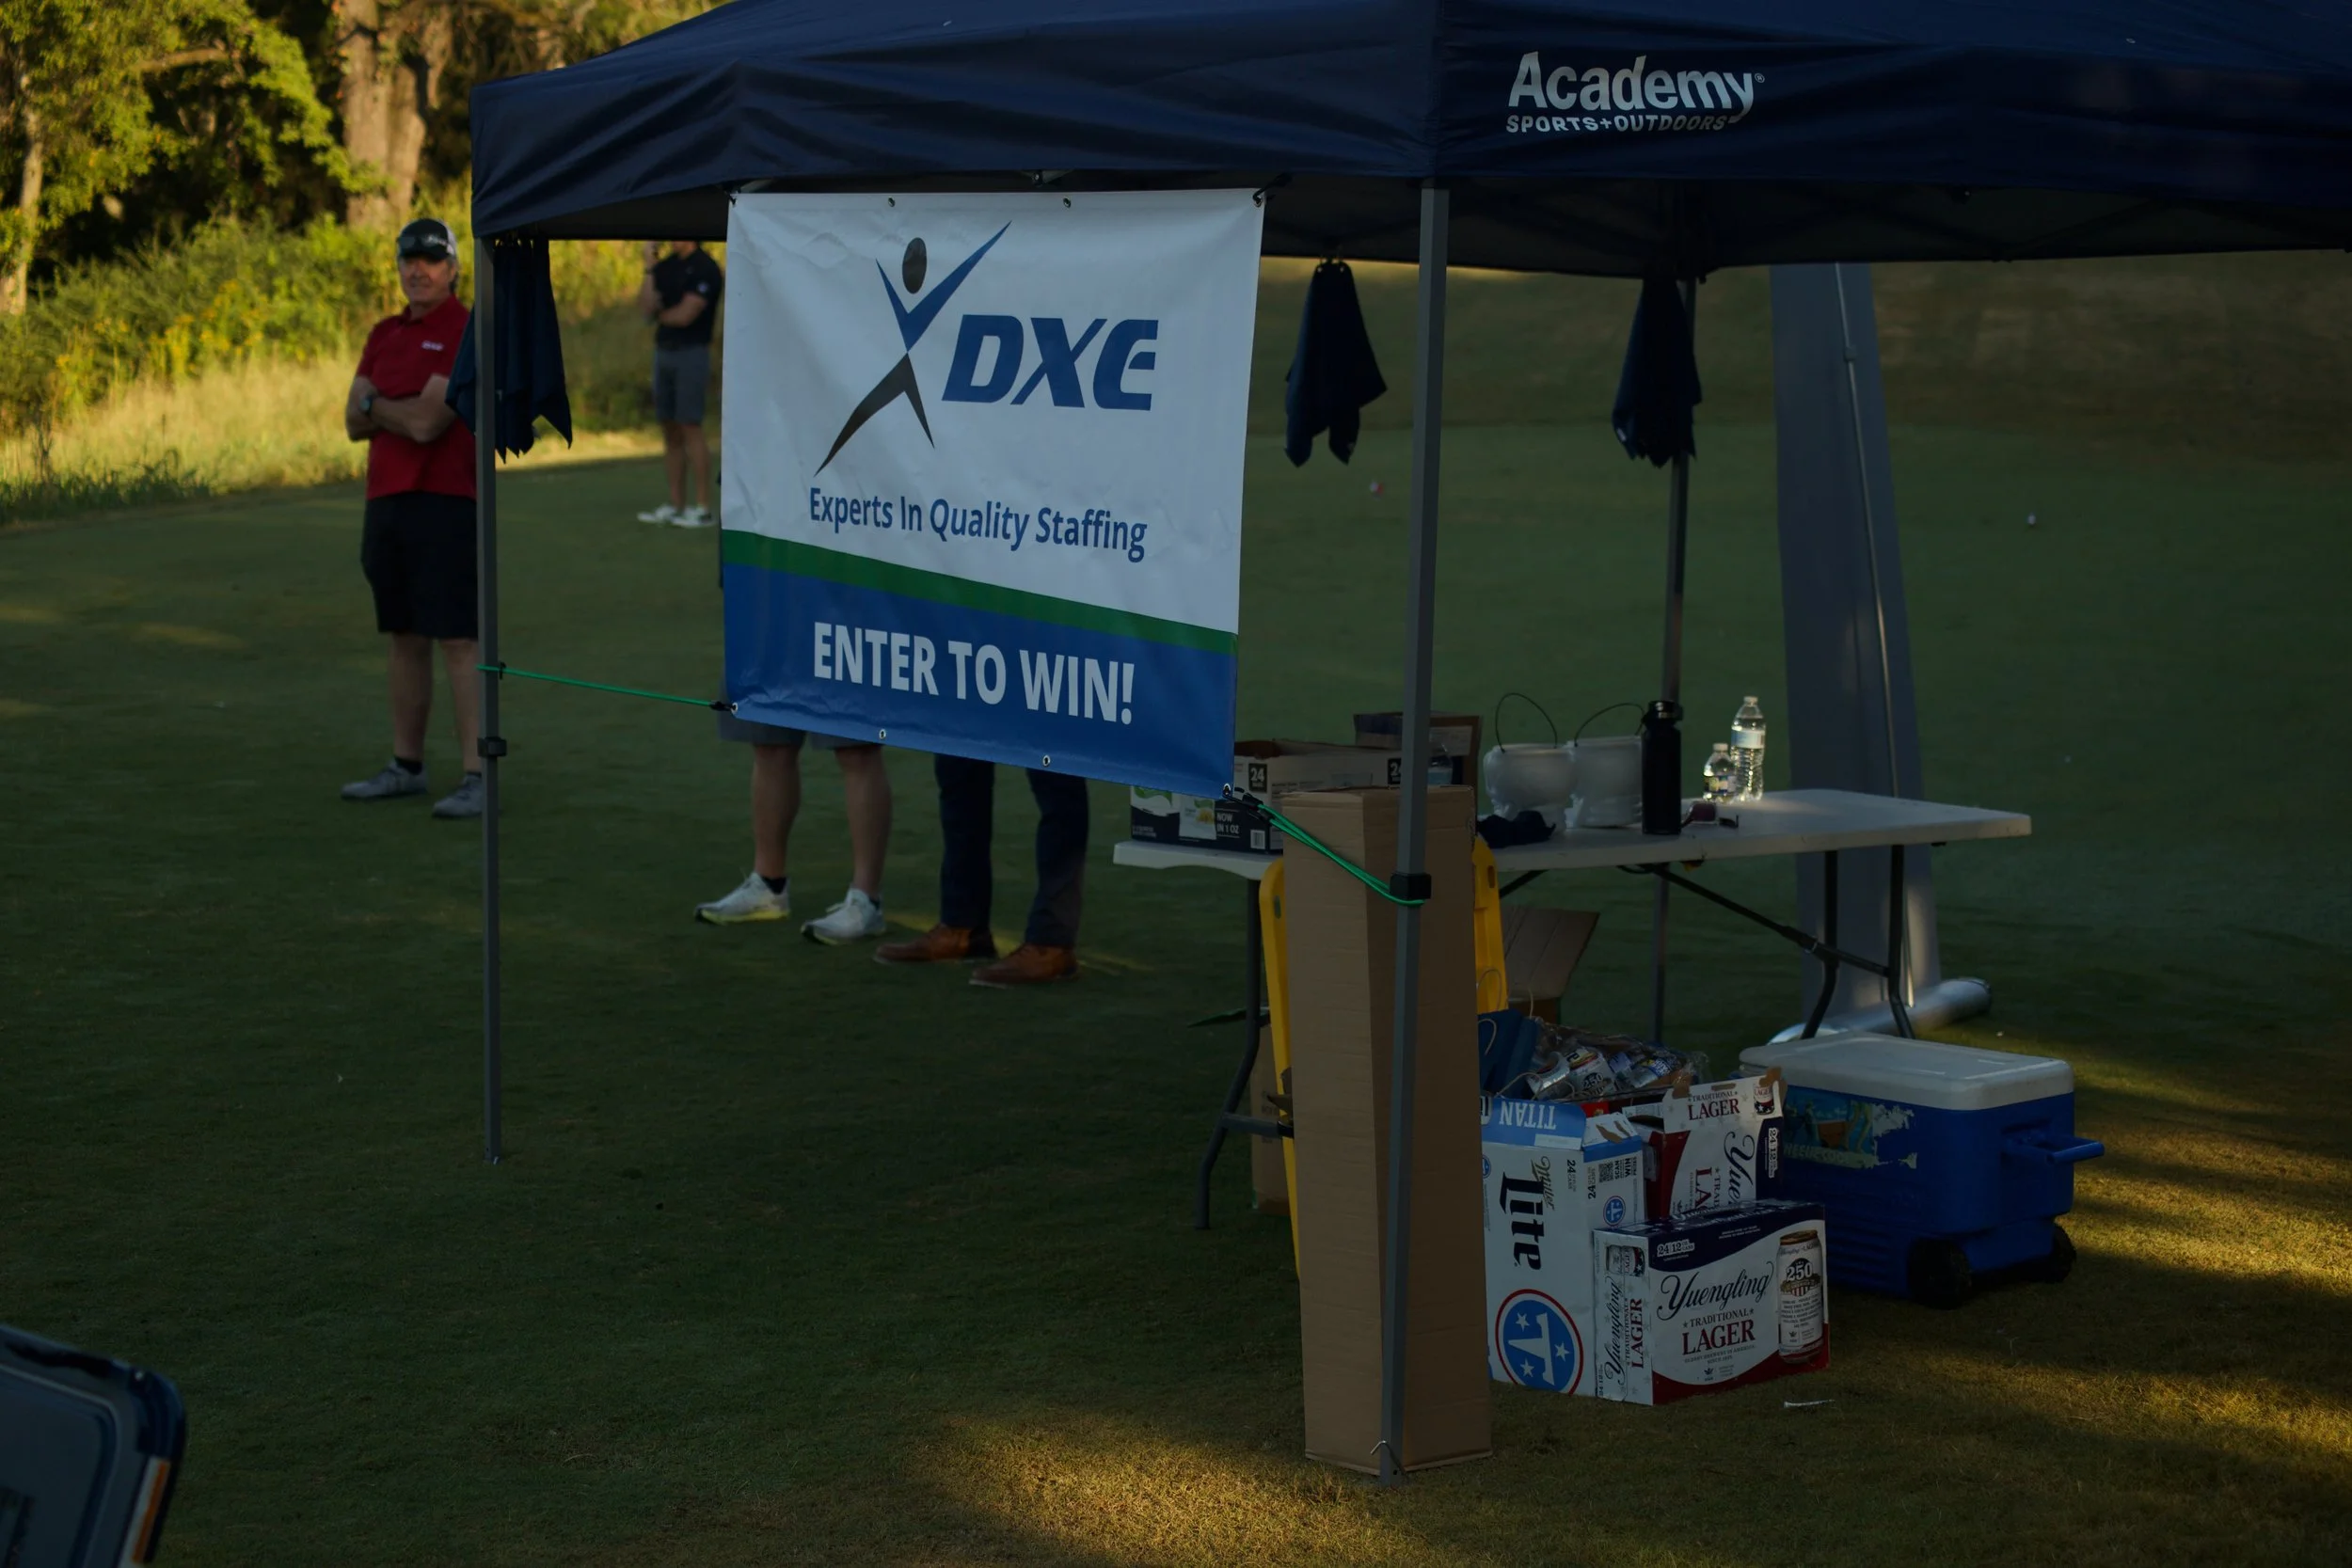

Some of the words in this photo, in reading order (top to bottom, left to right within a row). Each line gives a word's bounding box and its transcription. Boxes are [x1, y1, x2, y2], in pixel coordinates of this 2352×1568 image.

[1508, 51, 1755, 123] Academy
[1505, 114, 1729, 133] SPORTS+OUTDOORS
[942, 314, 1158, 411] DXE
[809, 486, 893, 533] Experts
[900, 496, 922, 532] In
[930, 499, 1029, 552] Quality
[1036, 507, 1148, 563] Staffing
[814, 621, 939, 696] ENTER
[947, 640, 1007, 705] TO
[1019, 649, 1135, 725] WIN!
[1249, 767, 1266, 783] 24
[1216, 813, 1233, 824] NOW
[1692, 1089, 1735, 1102] TRADITIONAL
[1499, 1101, 1557, 1131] TITAN
[1688, 1098, 1740, 1121] LAGER
[1567, 1159, 1576, 1174] 24
[1624, 1158, 1632, 1178] WIN
[1587, 1184, 1597, 1199] 24
[1500, 1171, 1545, 1270] Lite
[1657, 1243, 1670, 1256] 24
[1671, 1242, 1682, 1254] 12
[1786, 1261, 1814, 1283] 250
[1656, 1260, 1774, 1321] Yuengling
[1689, 1307, 1749, 1327] TRADITIONAL
[1604, 1275, 1626, 1386] Yuengling
[1630, 1299, 1645, 1369] LAGER
[1681, 1319, 1756, 1355] LAGER
